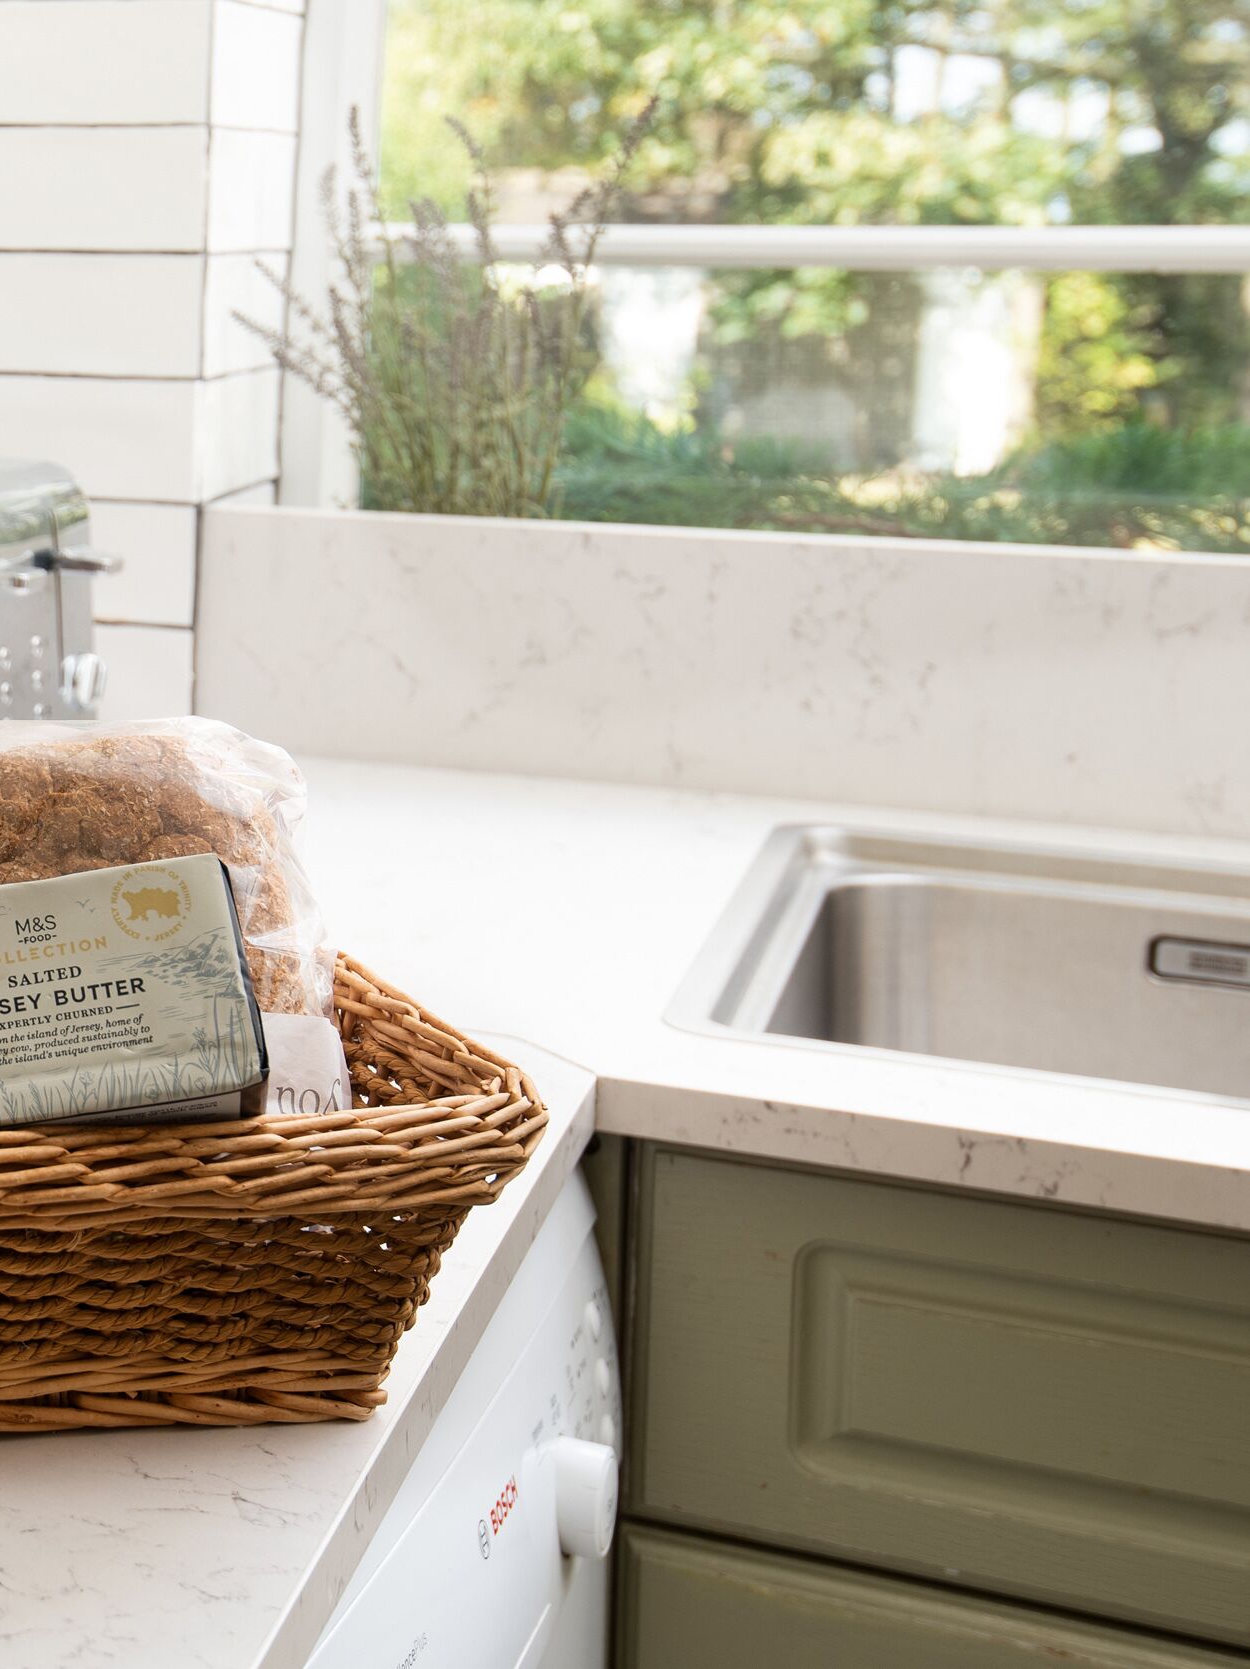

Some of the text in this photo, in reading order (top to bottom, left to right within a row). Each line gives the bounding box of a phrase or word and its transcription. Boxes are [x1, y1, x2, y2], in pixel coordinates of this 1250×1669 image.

[15, 914, 57, 935] M&S
[7, 965, 82, 989] SALTED
[53, 977, 147, 1007] BUTTER
[10, 1032, 25, 1043] the
[27, 1027, 59, 1041] island
[59, 1025, 70, 1037] of
[70, 1022, 104, 1034] Jersey,
[105, 1017, 132, 1028] home
[132, 1013, 144, 1025] of
[55, 1005, 114, 1021] CHURNED
[10, 1045, 33, 1055] cow,
[34, 1034, 80, 1052] produced
[81, 1026, 139, 1043] sustainably
[140, 1025, 151, 1034] to
[15, 1050, 53, 1064] island's
[54, 1045, 90, 1057] unique
[90, 1034, 154, 1052] environment
[490, 1473, 519, 1536] BOSCH
